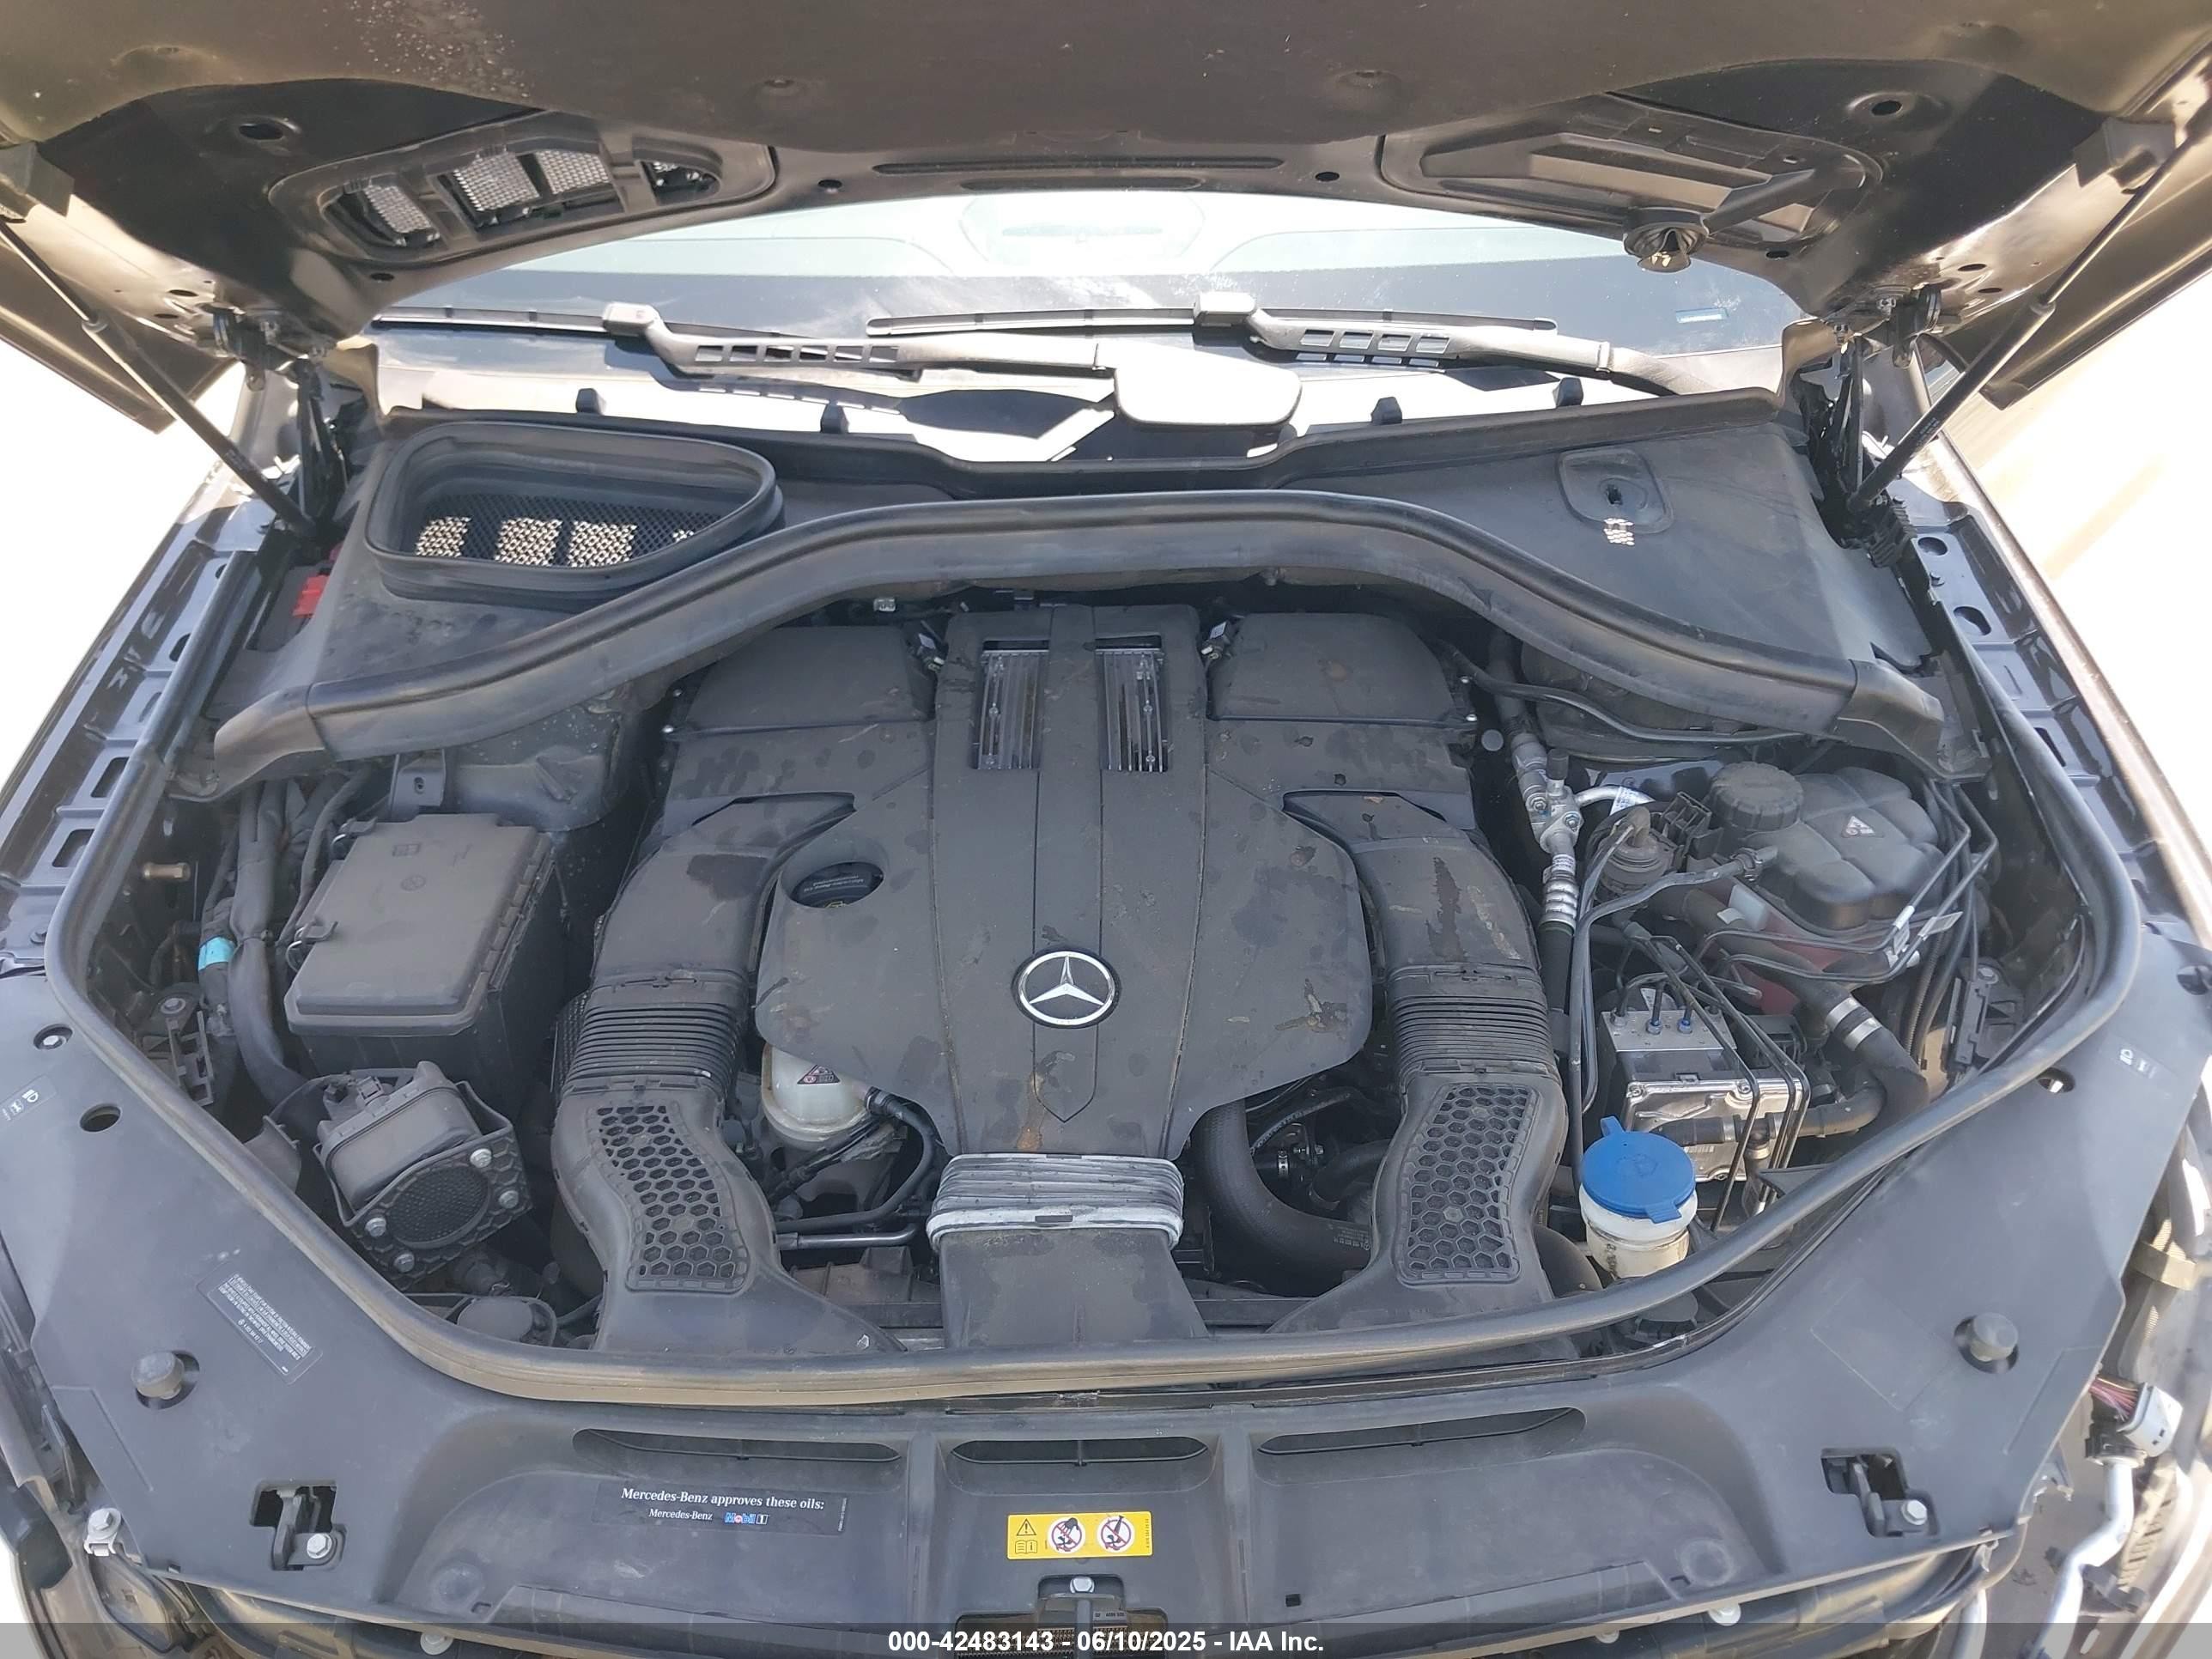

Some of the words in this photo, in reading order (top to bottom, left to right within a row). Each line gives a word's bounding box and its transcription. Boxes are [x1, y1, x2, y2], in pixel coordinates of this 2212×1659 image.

[621, 1487, 708, 1504] Mercedes-Benz
[710, 1496, 763, 1507] approves
[766, 1497, 797, 1508] these
[799, 1498, 824, 1510] oils:
[648, 1509, 713, 1521] Mercedes-Benz
[724, 1512, 757, 1524] Mobil
